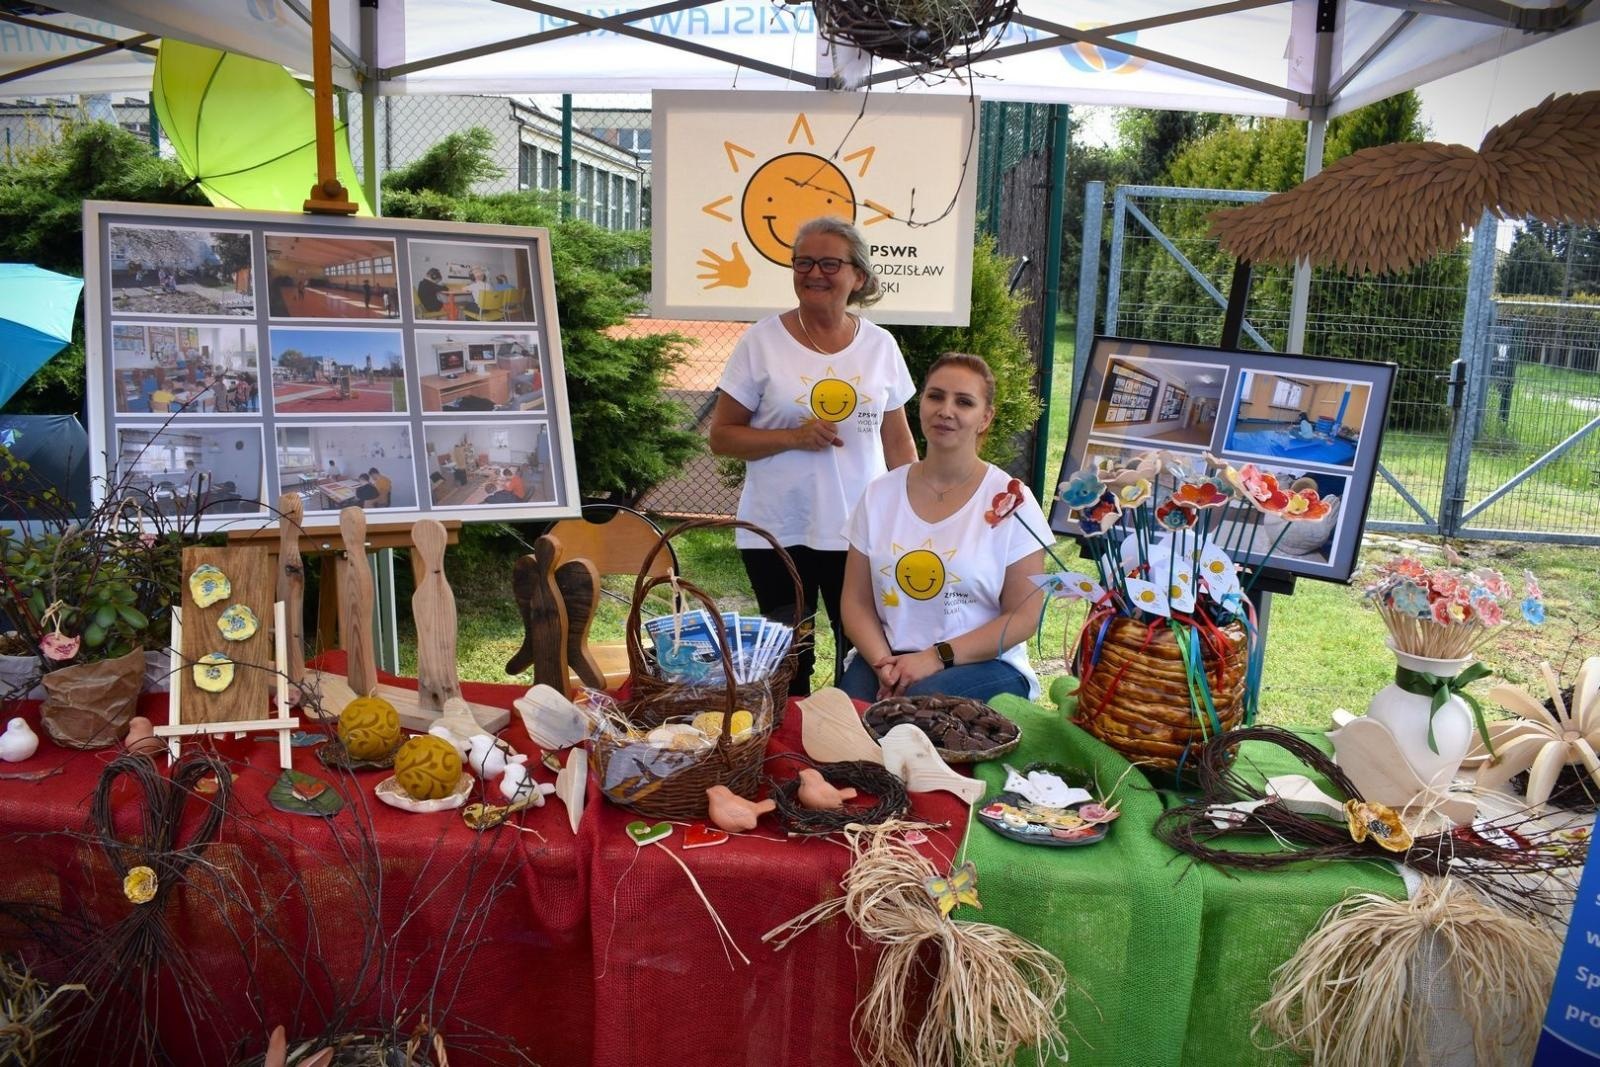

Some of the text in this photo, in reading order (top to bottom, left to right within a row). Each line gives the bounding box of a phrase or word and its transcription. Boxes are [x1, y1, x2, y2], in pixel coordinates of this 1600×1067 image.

[870, 245, 918, 258] PSWR
[871, 263, 944, 276] ODZISŁAW
[880, 282, 900, 293] SKI
